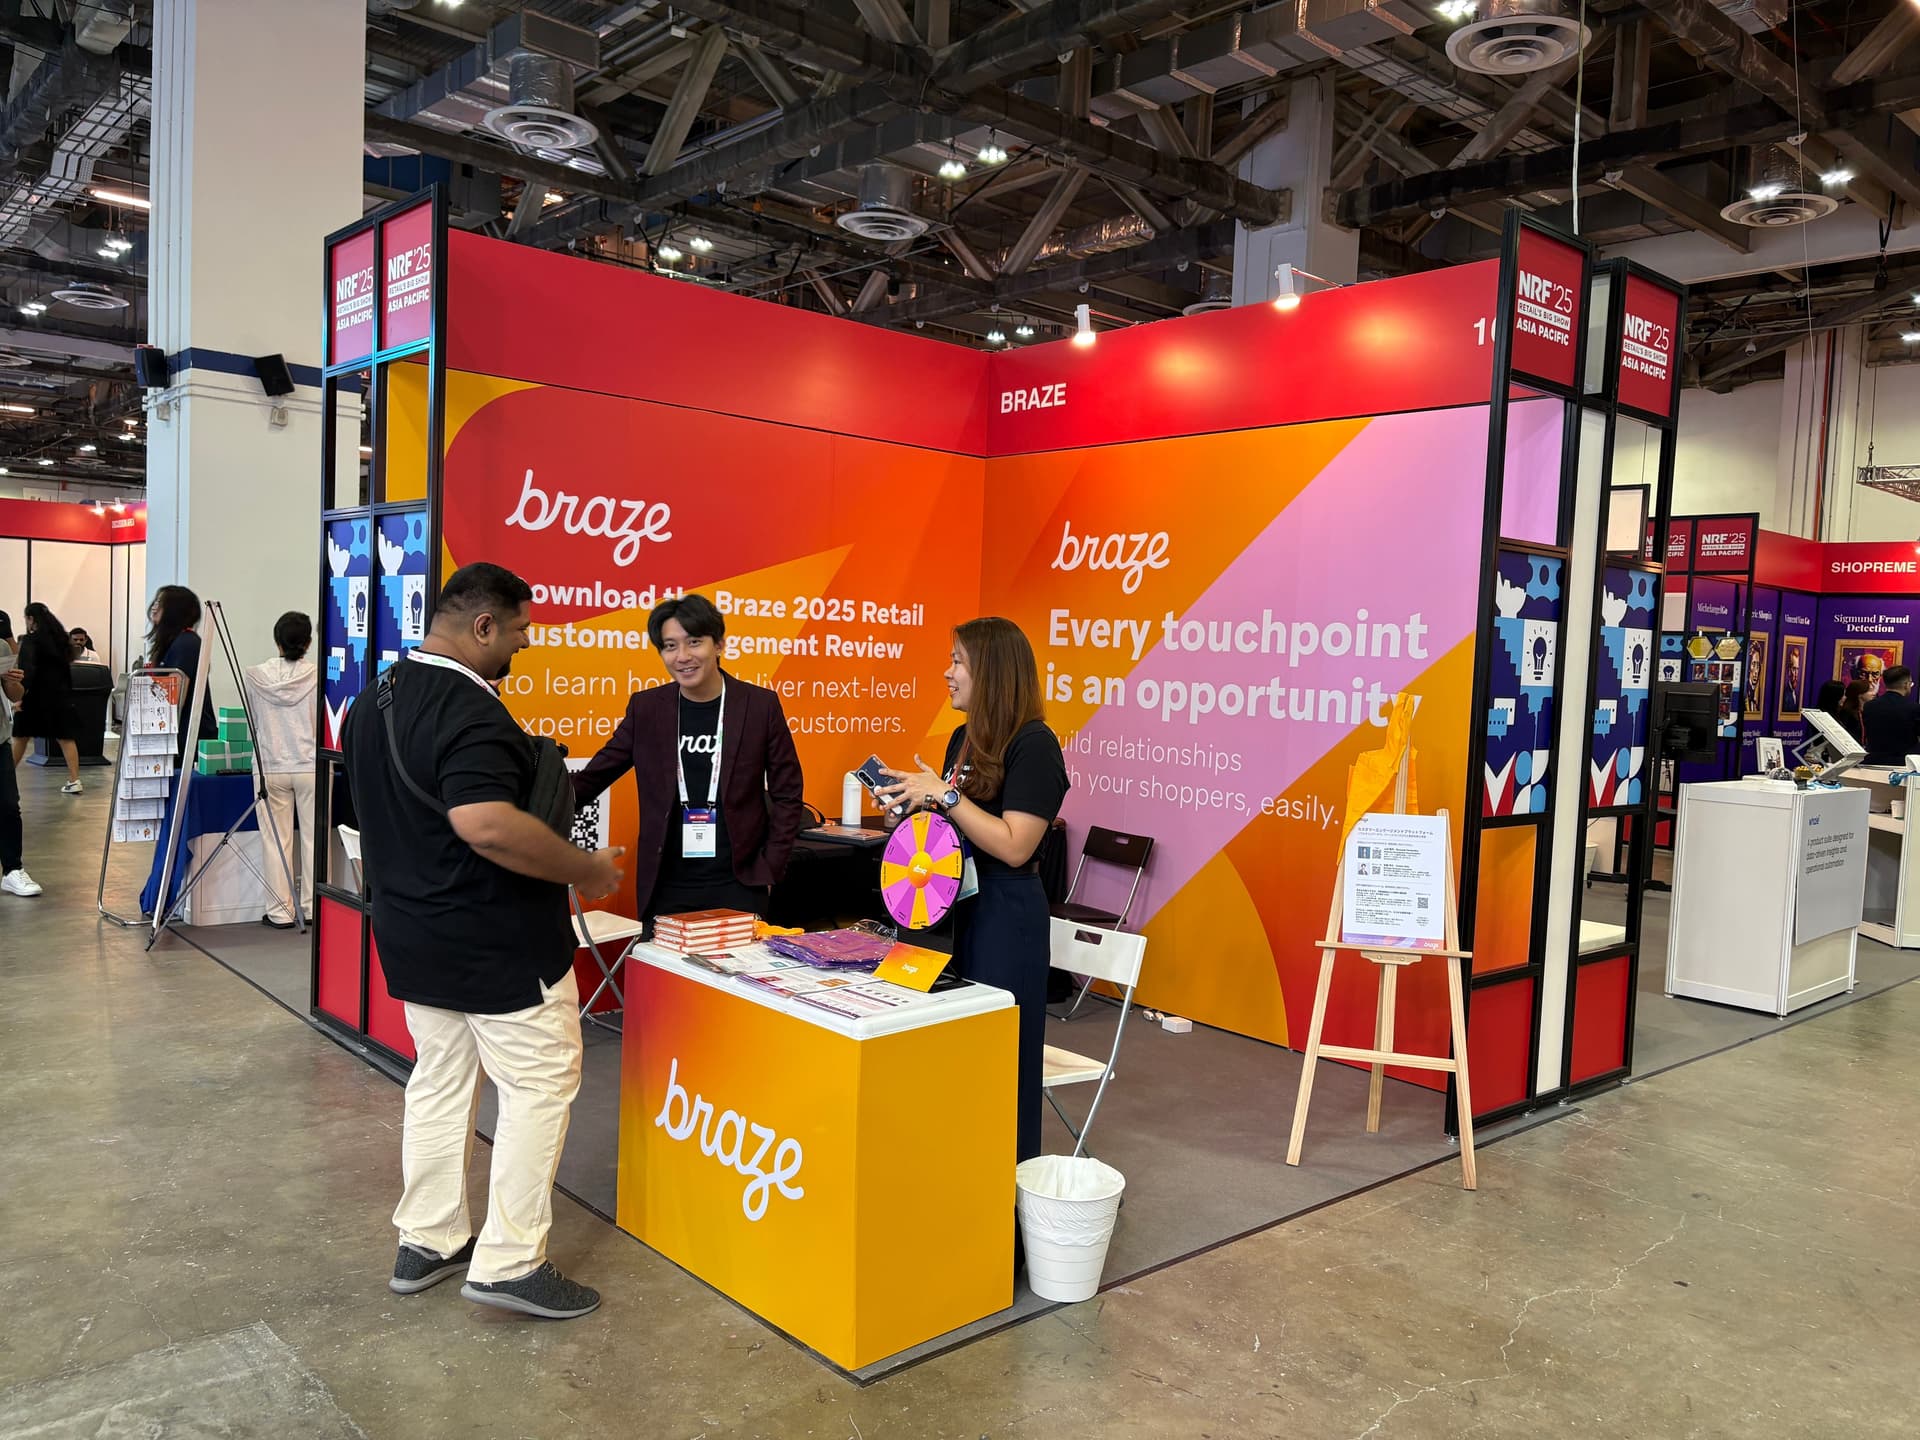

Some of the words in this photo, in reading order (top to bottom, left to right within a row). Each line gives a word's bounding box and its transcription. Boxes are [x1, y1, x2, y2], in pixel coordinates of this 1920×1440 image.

[388, 299, 403, 313] ASIA
[404, 288, 430, 308] PACIFIC
[1519, 302, 1542, 320] RETAIL'S
[1543, 310, 1553, 321] BIG
[1553, 313, 1570, 328] SHOW
[336, 316, 350, 331] ASIA
[350, 309, 373, 326] PACIFIC
[1516, 317, 1537, 335] ASIA
[1538, 325, 1569, 346] PACIFIC
[1622, 355, 1639, 371] ASIA
[1640, 361, 1667, 380] PACIFIC
[1653, 350, 1667, 363] SHOW
[1001, 383, 1067, 414] BRAZE
[505, 469, 673, 567] braze
[1052, 521, 1170, 594] braze
[1831, 561, 1917, 573] SHOPREME
[525, 577, 656, 609] ownload
[715, 590, 786, 618] Braze
[792, 596, 856, 622] 2025
[861, 600, 924, 626] Retail
[1833, 614, 1876, 624] Sigmund
[1878, 614, 1910, 624] Fraud
[1846, 624, 1895, 633] Detection
[528, 623, 651, 651] ustomer
[723, 634, 819, 660] gement
[825, 634, 903, 659] Review
[1049, 609, 1151, 661] Every
[1162, 608, 1429, 668] touchpoint
[504, 673, 534, 695] to
[545, 668, 617, 696] learn
[812, 675, 916, 699] next-level
[1046, 662, 1073, 703] is
[1082, 673, 1126, 706] an
[786, 712, 906, 734] customers.
[1056, 730, 1092, 755] uild
[1098, 734, 1243, 776] relationships
[1087, 772, 1133, 796] your
[1139, 774, 1252, 817] shoppers,
[1260, 794, 1340, 830] easily.
[654, 1057, 805, 1221] braze
